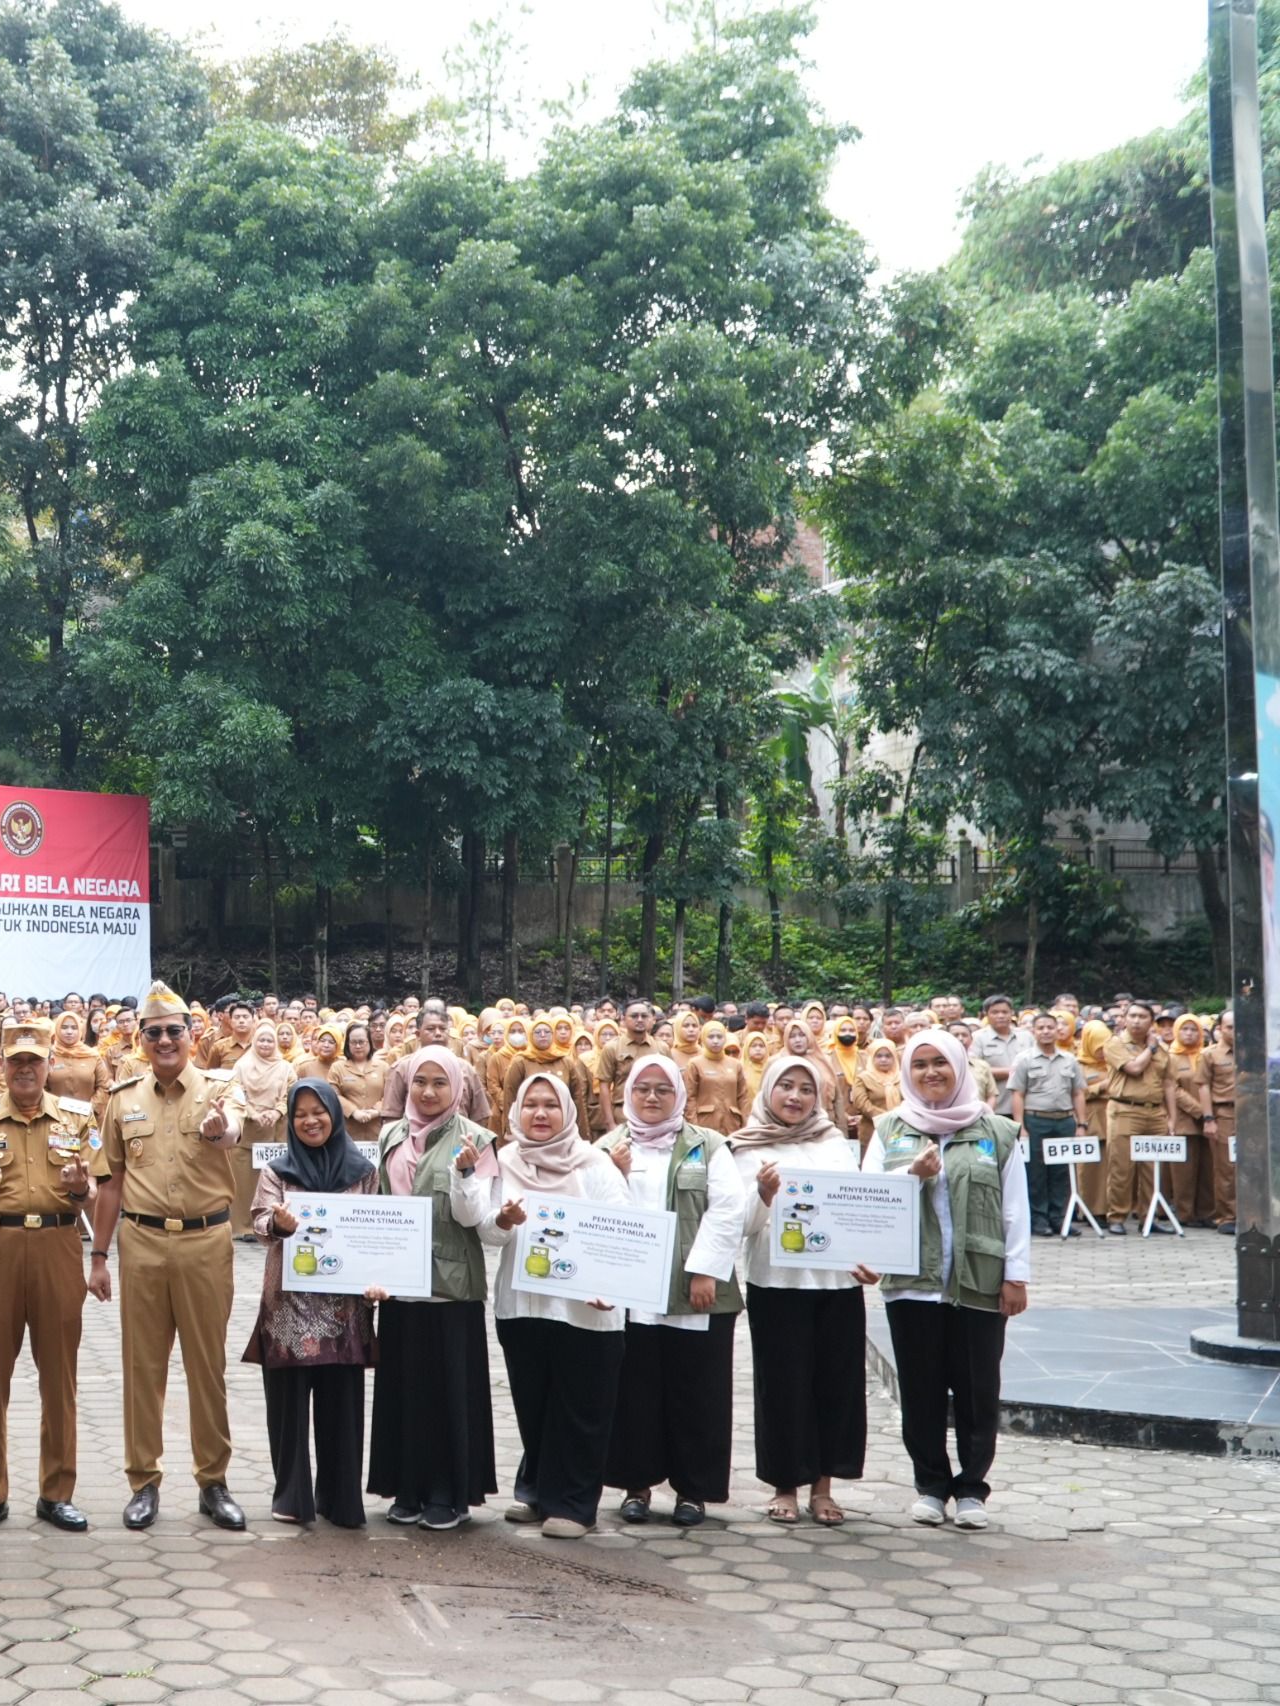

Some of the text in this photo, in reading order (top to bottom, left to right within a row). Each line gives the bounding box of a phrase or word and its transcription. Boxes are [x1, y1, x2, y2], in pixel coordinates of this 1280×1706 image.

[25, 875, 69, 894] BELA
[74, 877, 141, 897] NEGARA
[53, 904, 86, 918] BELA
[90, 906, 141, 920] NEGARA
[26, 920, 99, 934] INDONESIA
[103, 922, 137, 935] MAJU
[1048, 1143, 1095, 1157] BPBD
[1134, 1142, 1181, 1154] DISNAKER
[839, 1185, 890, 1195] PENYERAHAN
[827, 1193, 903, 1204] BANTUAN STIMULAN
[352, 1208, 403, 1217] PENYERAHAN
[340, 1216, 415, 1225] BANTUAN STIMULAN
[592, 1215, 645, 1230] PENYERAHAN
[578, 1221, 617, 1233] BANTUAN
[617, 1226, 657, 1239] STIMULAN
